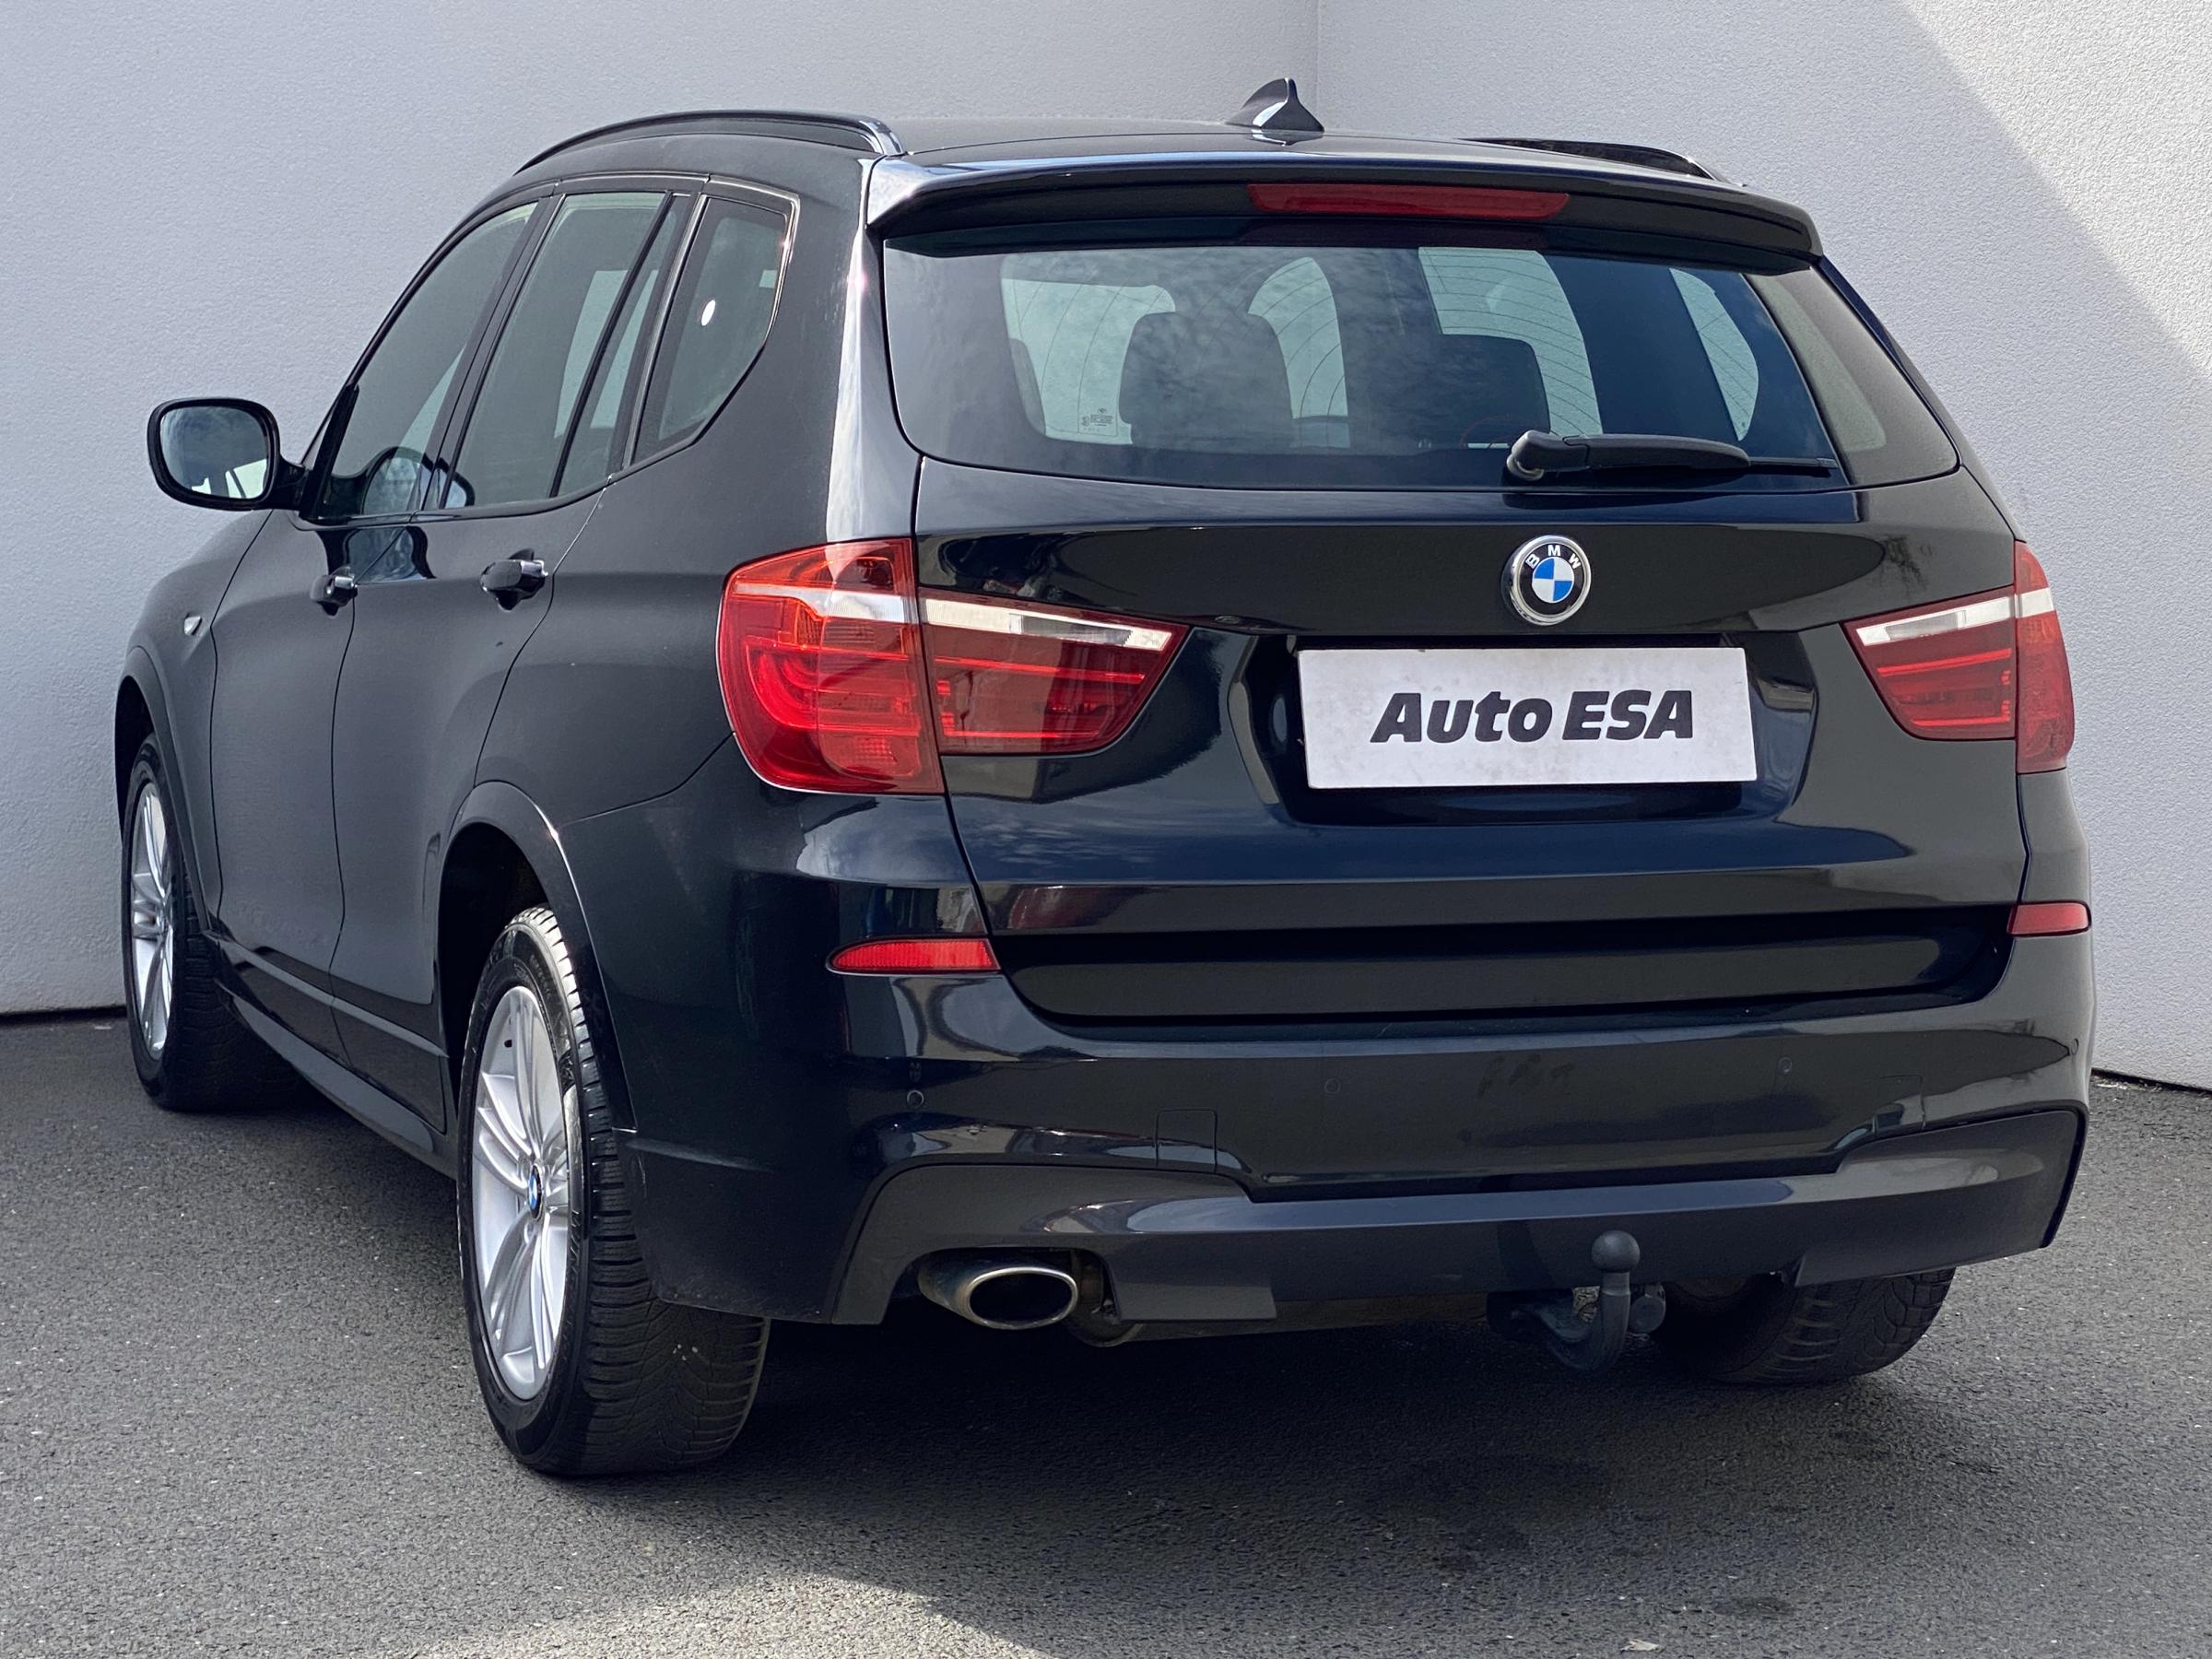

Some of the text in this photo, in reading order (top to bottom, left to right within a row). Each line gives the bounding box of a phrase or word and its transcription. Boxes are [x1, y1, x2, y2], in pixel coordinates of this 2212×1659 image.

[1525, 544, 1582, 569] BMW
[1370, 689, 1693, 744] Auto ESA
